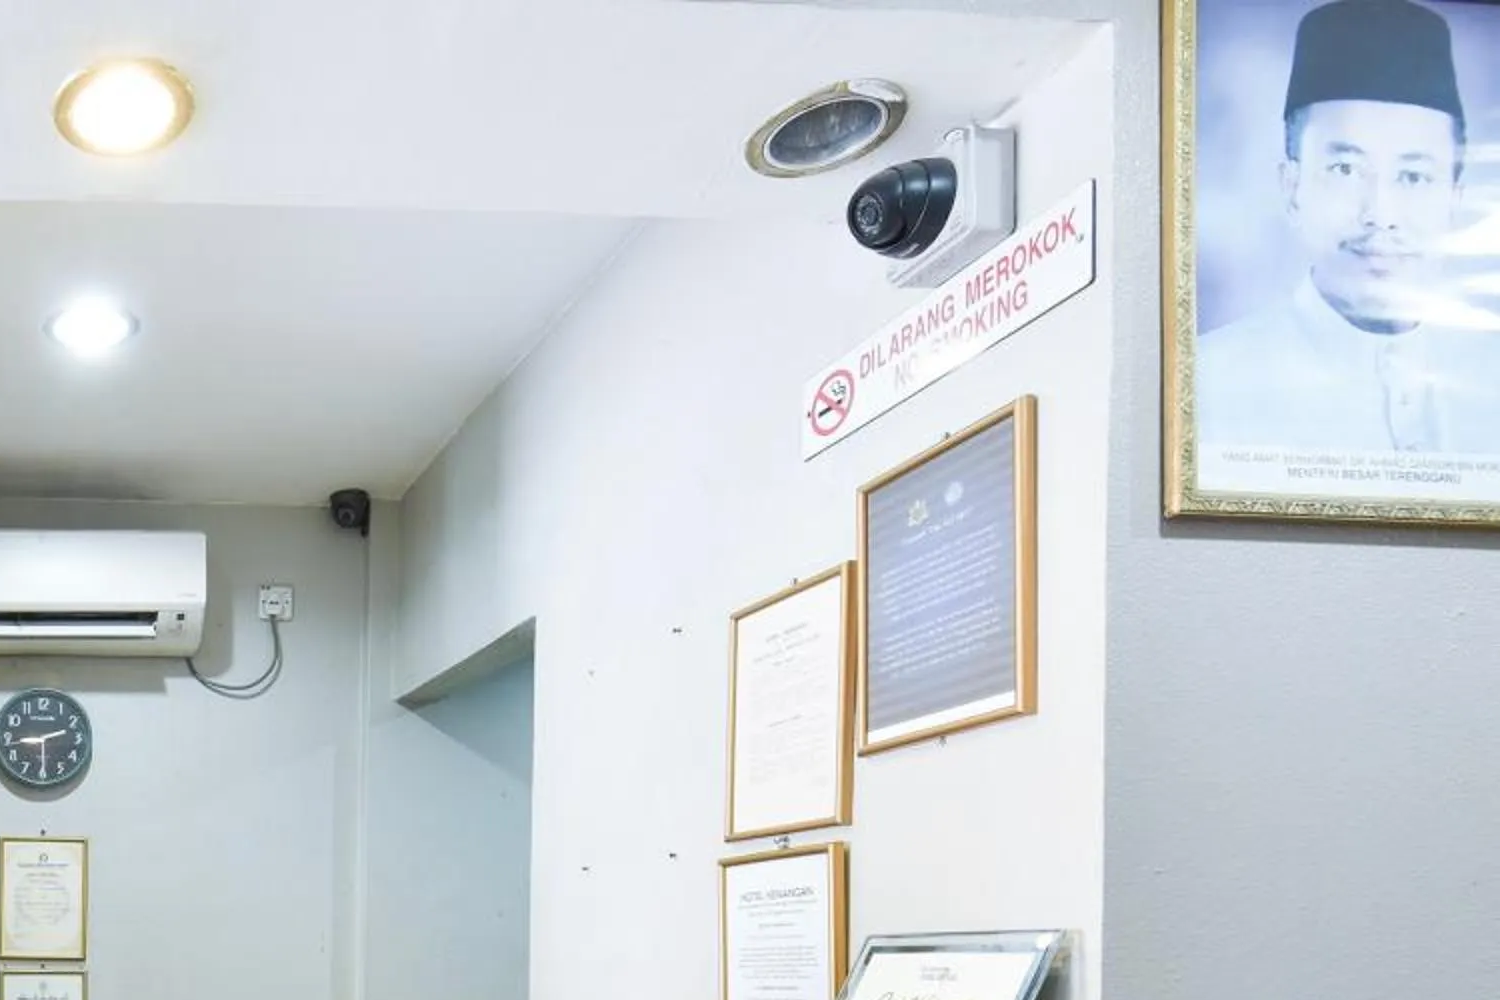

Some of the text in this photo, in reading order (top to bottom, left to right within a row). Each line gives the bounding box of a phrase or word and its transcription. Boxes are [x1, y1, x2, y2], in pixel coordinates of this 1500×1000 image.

[859, 207, 1077, 380] DILARANG MEROKOK
[22, 701, 31, 715] 11
[37, 697, 50, 711] 12
[7, 713, 21, 727] 10
[68, 715, 79, 729] 2
[3, 731, 12, 746] 9
[74, 731, 83, 745] 3
[67, 749, 77, 762] 4
[20, 761, 30, 774] 7
[56, 761, 65, 775] 5
